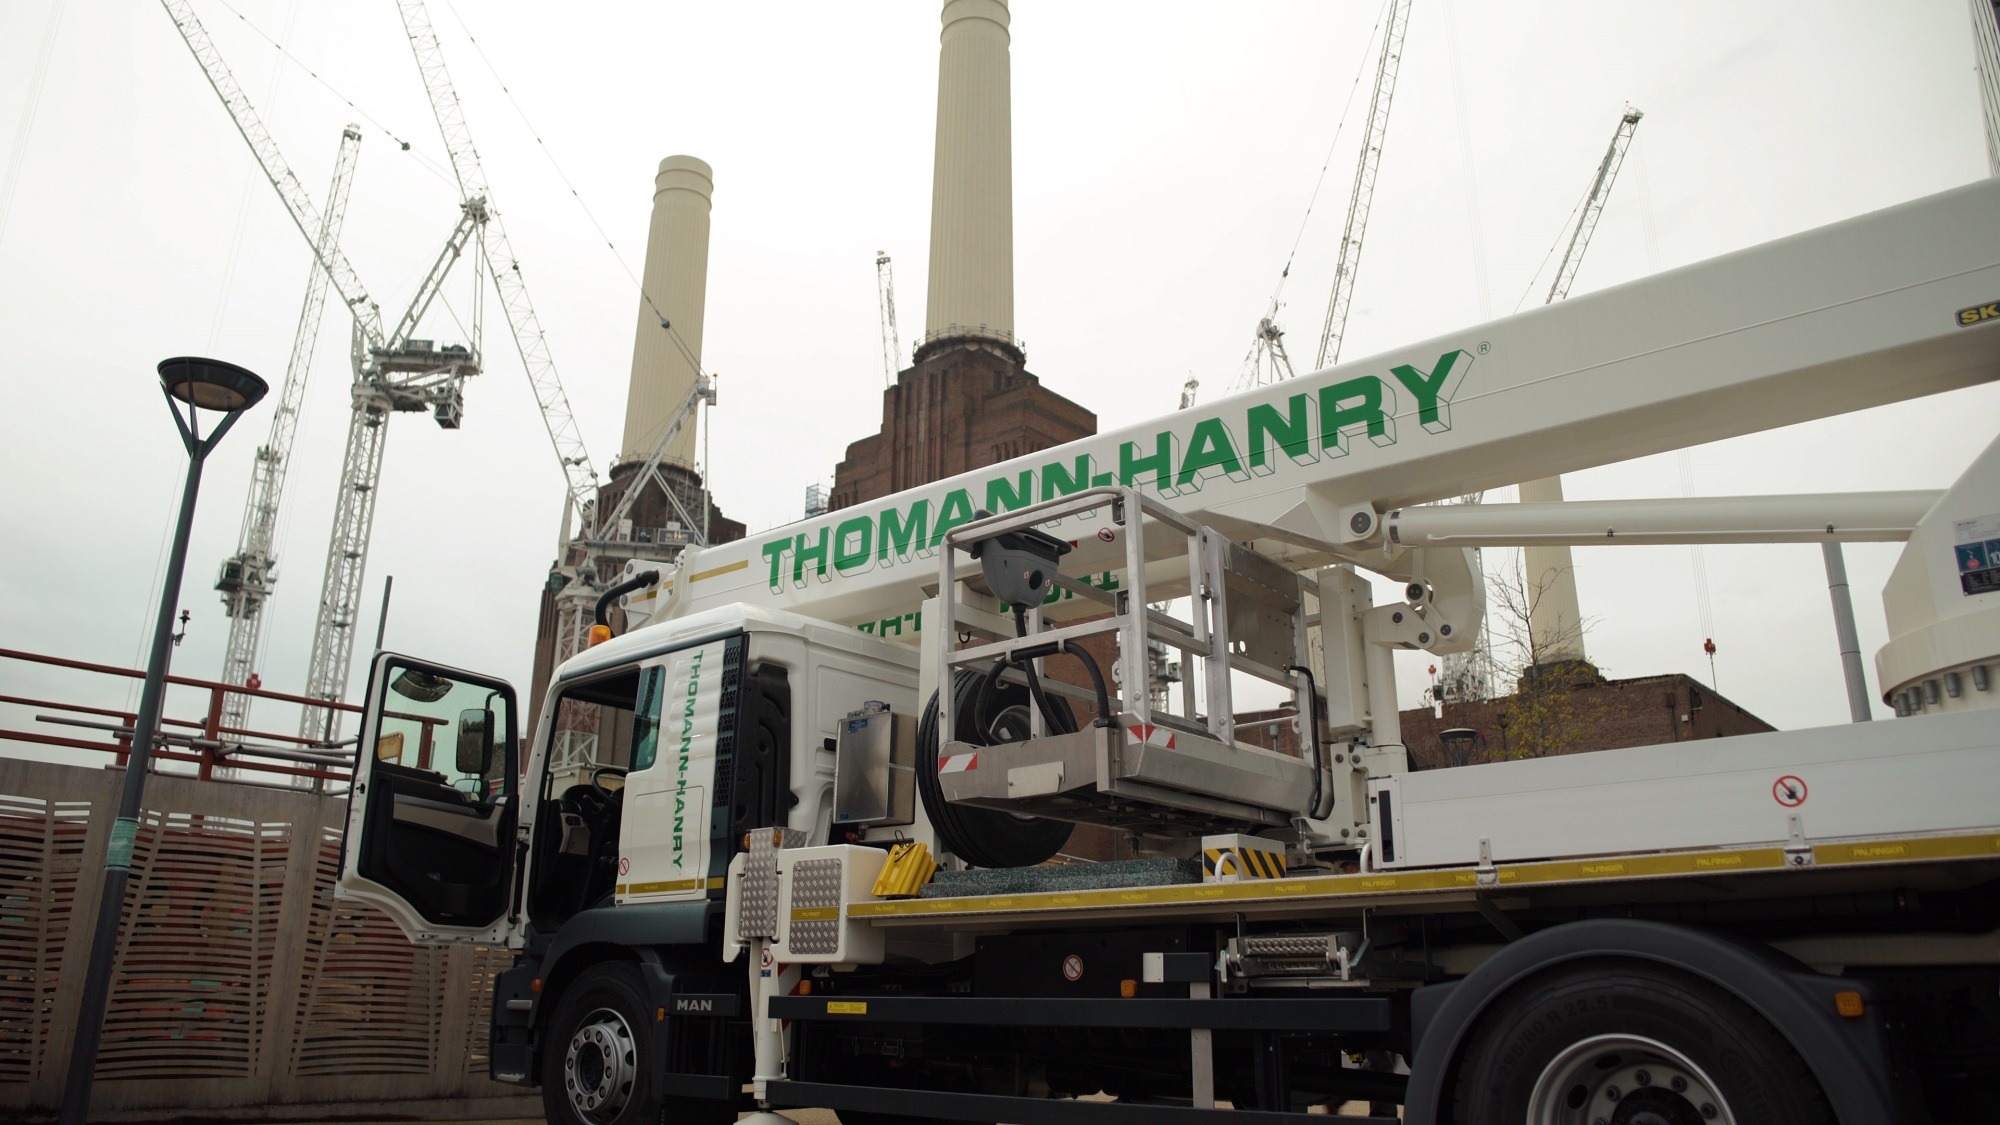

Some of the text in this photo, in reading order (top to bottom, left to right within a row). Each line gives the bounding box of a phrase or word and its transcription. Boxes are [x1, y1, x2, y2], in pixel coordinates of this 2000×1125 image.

[672, 650, 704, 869] THOMANN-HANRY
[1853, 844, 1904, 857] PALFINGER
[1696, 853, 1742, 866] PALFINGER
[1583, 864, 1624, 874] PALFINGER
[1275, 884, 1306, 892] PALFINGER
[1361, 879, 1397, 888] PALFINGER
[676, 1000, 713, 1011] MAN
